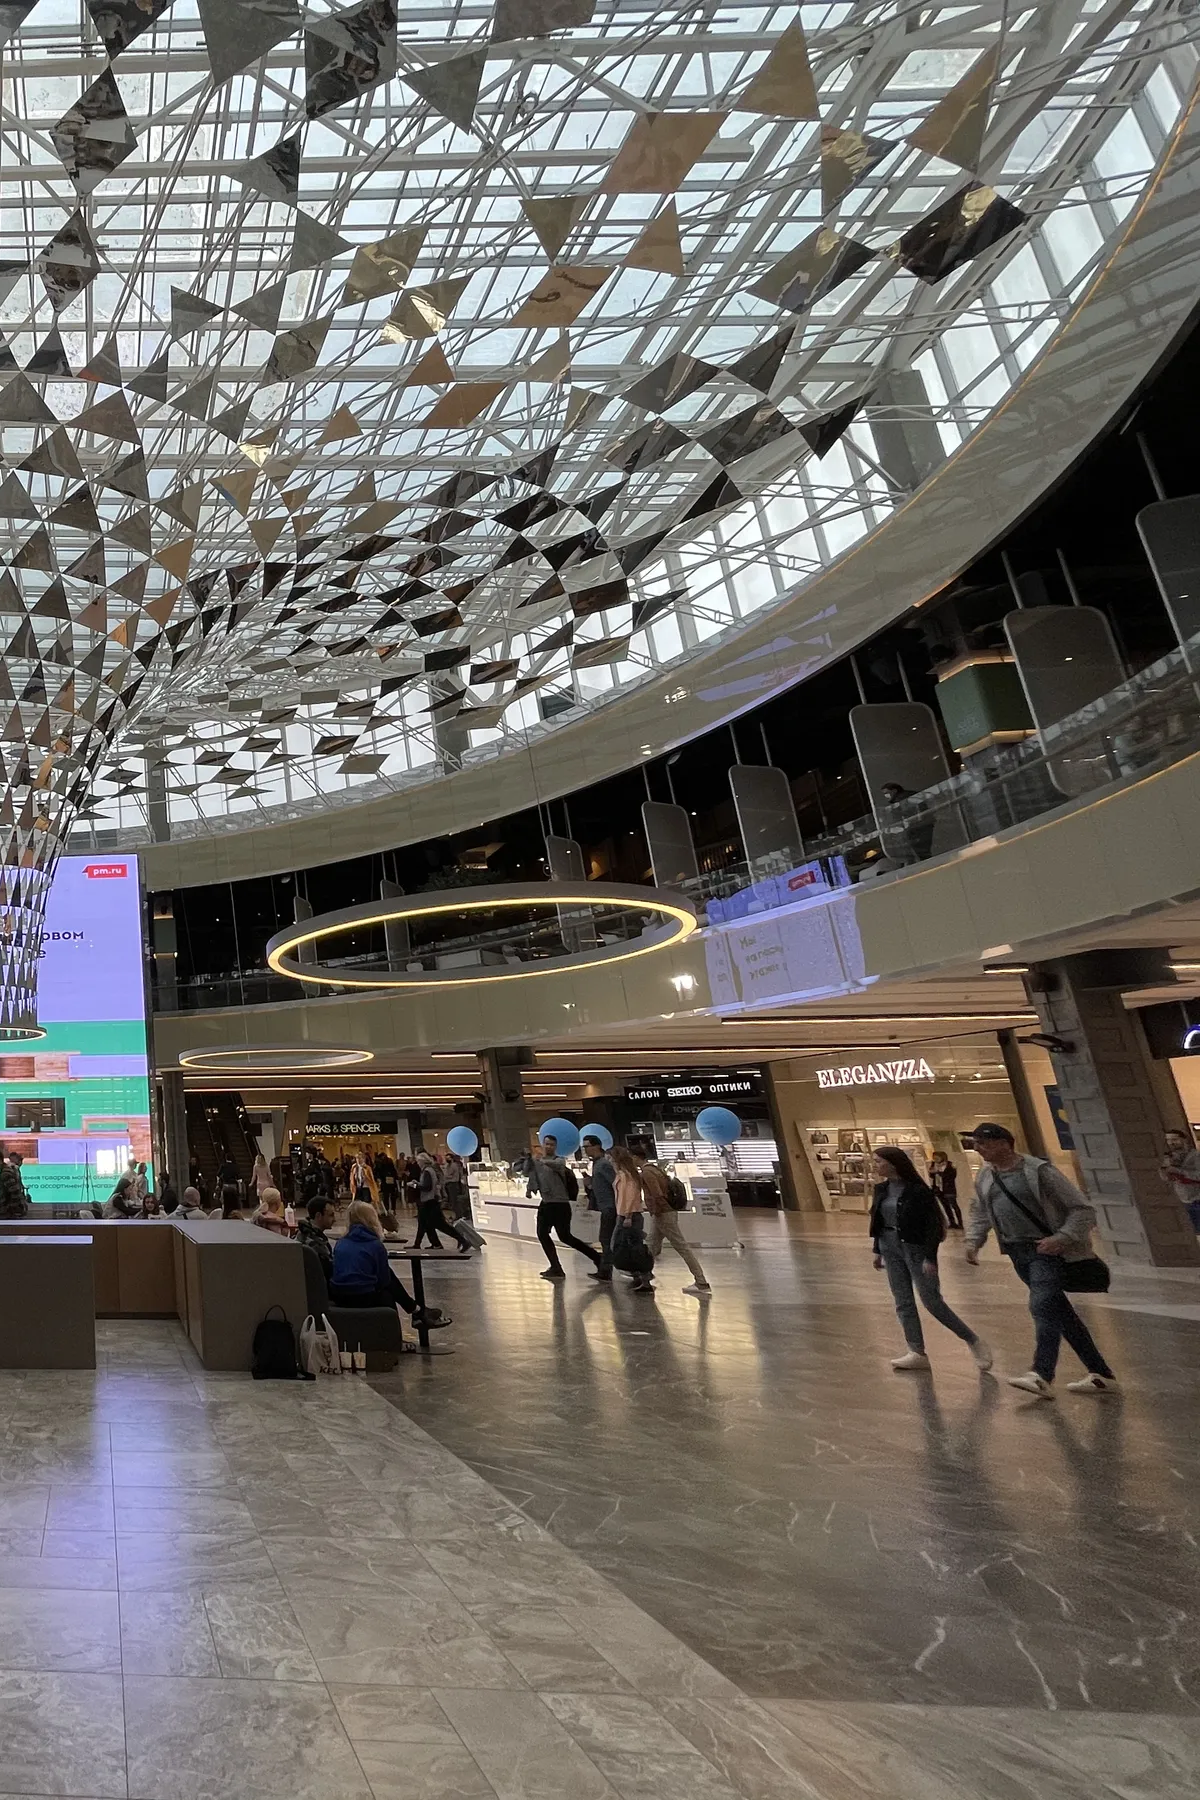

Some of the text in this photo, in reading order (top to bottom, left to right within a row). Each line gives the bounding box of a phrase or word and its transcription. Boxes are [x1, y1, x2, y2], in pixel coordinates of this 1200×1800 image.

[93, 867, 122, 877] pm.ru
[816, 1058, 935, 1088] ELEGANZZA
[628, 1081, 751, 1100] САЛОН SEIKO ОПТИКИ
[332, 1124, 339, 1133] &
[340, 1123, 381, 1133] SPENCER
